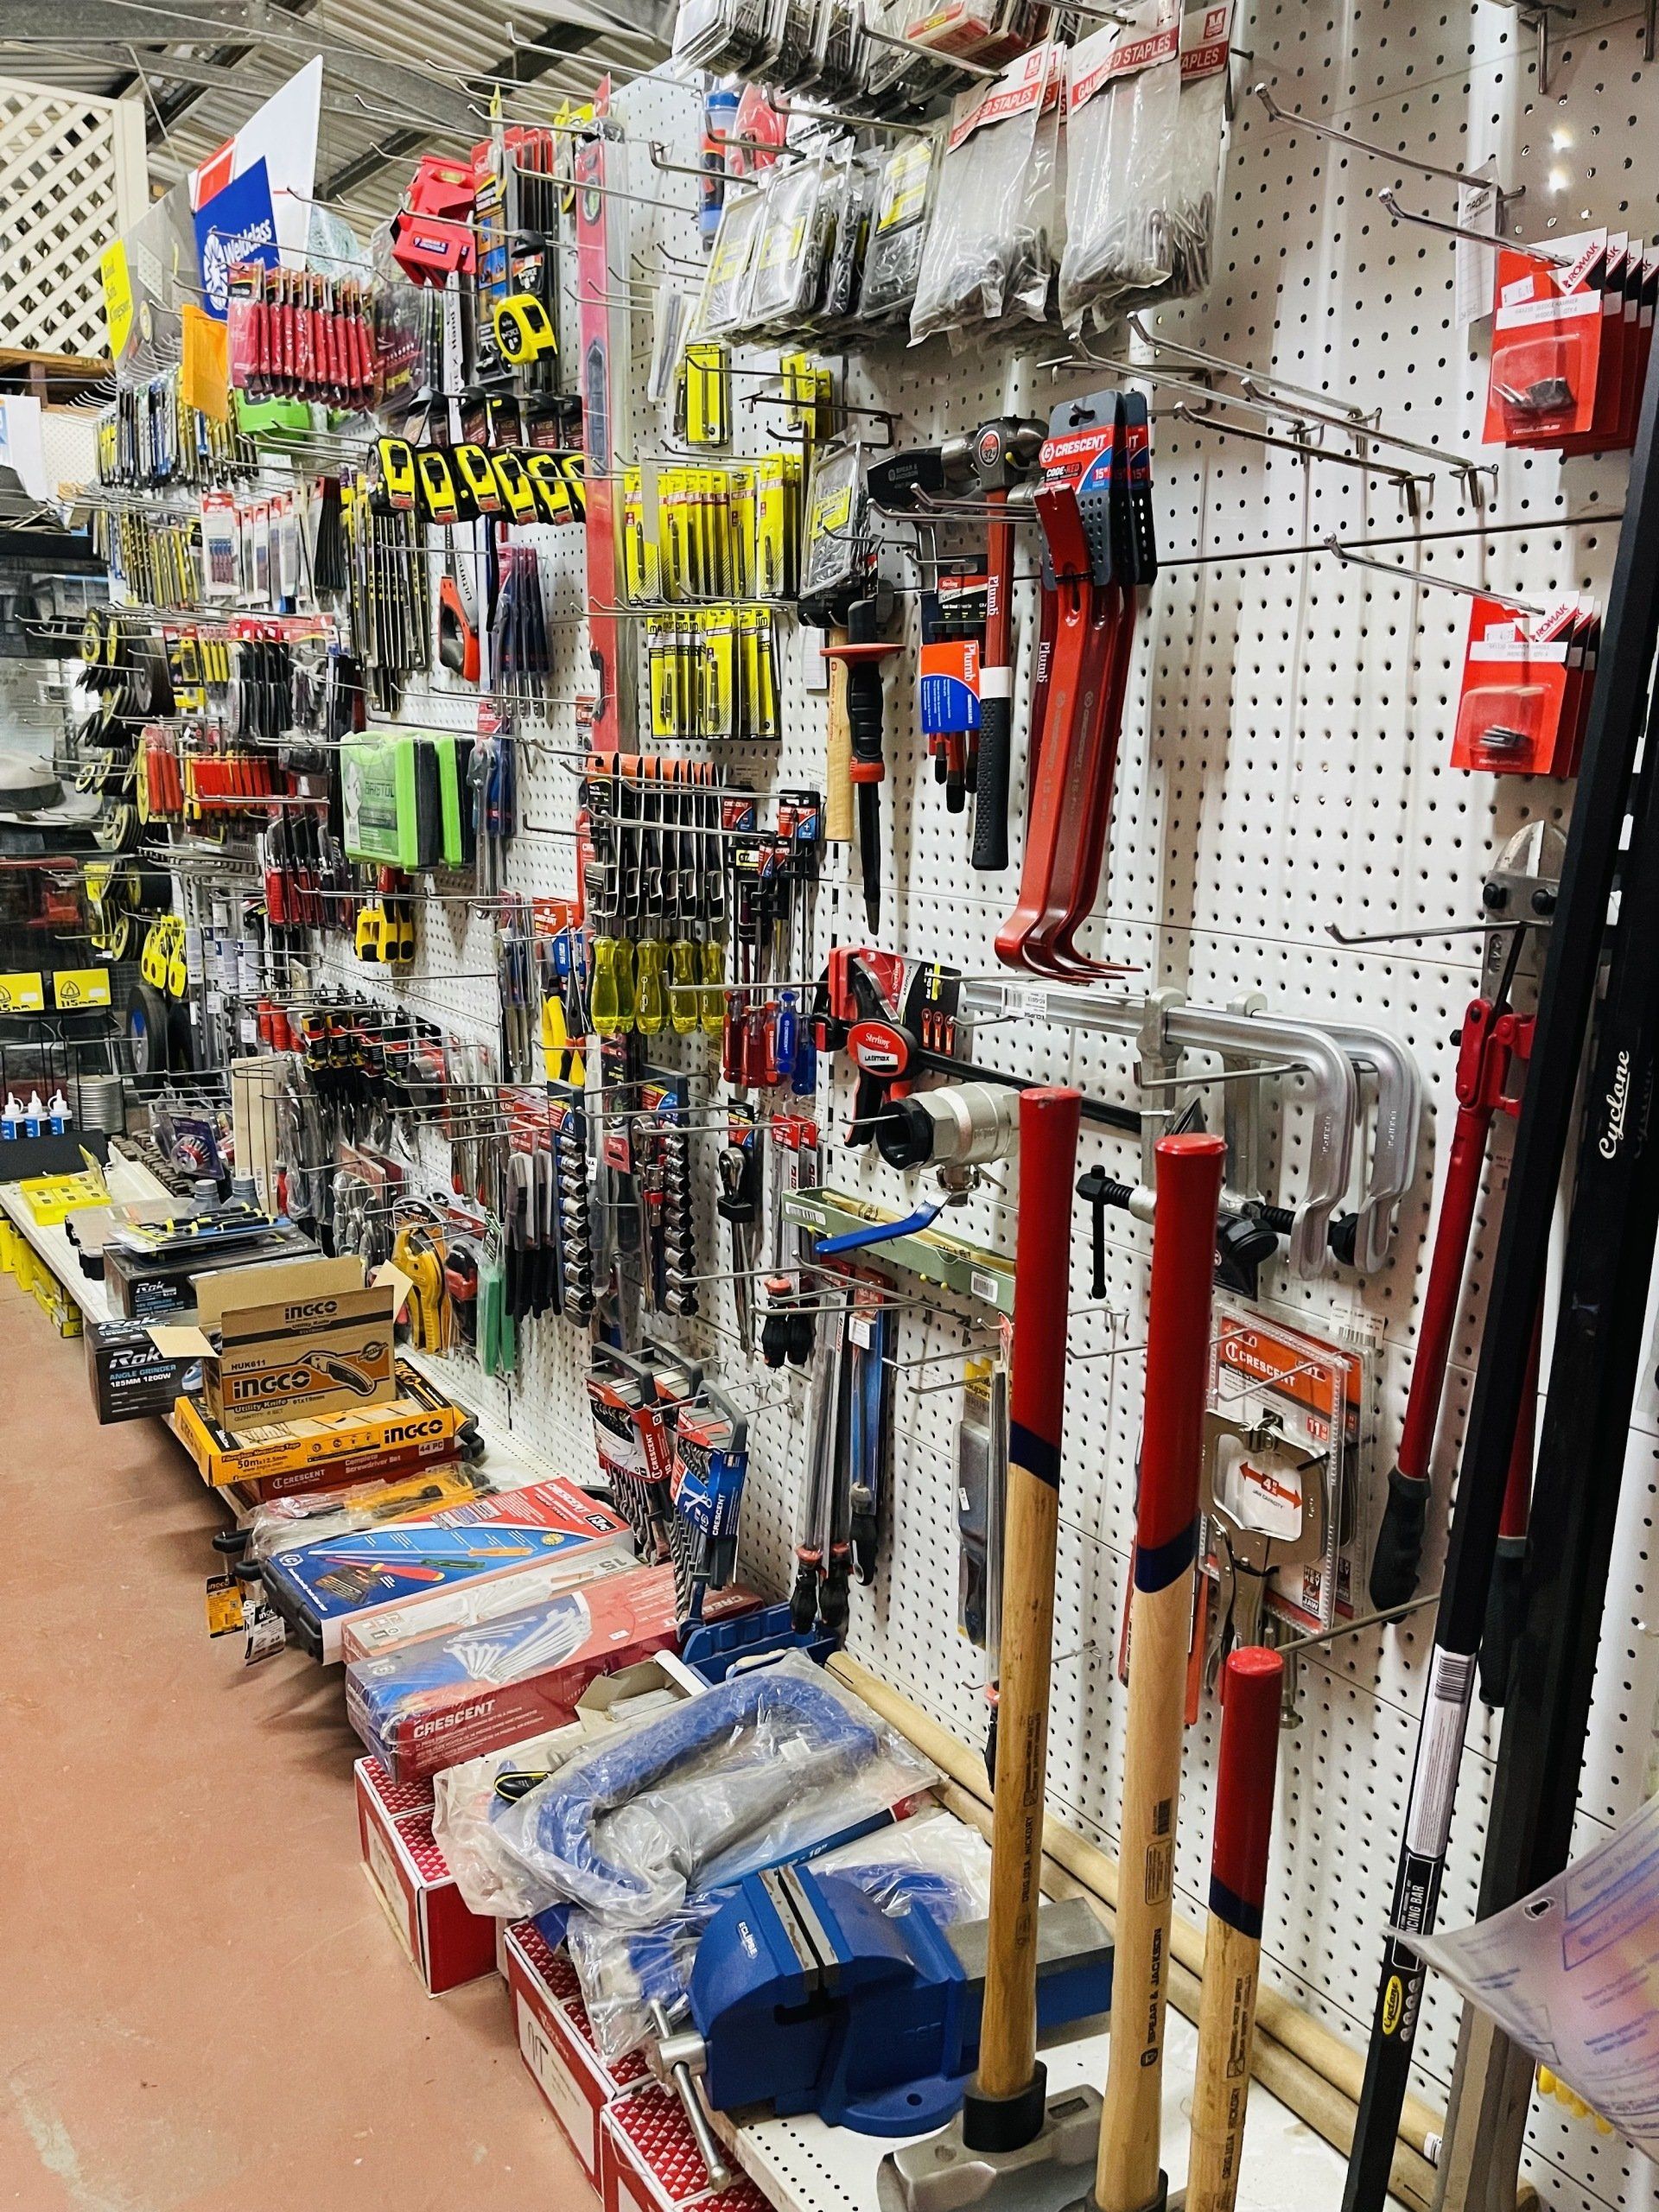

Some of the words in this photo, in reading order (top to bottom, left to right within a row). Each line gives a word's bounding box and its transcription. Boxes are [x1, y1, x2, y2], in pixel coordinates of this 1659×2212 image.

[1123, 34, 1171, 65] STAPLES
[1181, 47, 1220, 70] APLES
[991, 86, 1033, 116] STAPLES
[223, 219, 273, 265] Weldclass
[1567, 241, 1600, 283] ROMAK
[1054, 434, 1106, 458] CRESCENT
[988, 575, 1000, 616] Plumb
[1535, 602, 1568, 638] ROMAK
[963, 643, 976, 682] Plumb
[1037, 641, 1051, 683] Plumb
[60, 998, 99, 1008] 115mm
[865, 1032, 891, 1050] Sterling
[1599, 1050, 1630, 1160] Cyclone
[136, 1281, 165, 1294] Rok
[284, 1300, 338, 1320] INGCO
[109, 1346, 162, 1370] Rok
[110, 1370, 137, 1382] ANGLE
[140, 1363, 176, 1376] GRINDER
[1239, 1351, 1296, 1388] CRESCENT
[110, 1377, 142, 1389] 125MM
[143, 1372, 172, 1384] 1200W
[233, 1370, 312, 1400] INGCO
[233, 1402, 262, 1414] Utility
[262, 1398, 288, 1410] Knife
[384, 1419, 443, 1445] INGCO
[419, 1443, 431, 1453] 44
[432, 1441, 444, 1452] PC
[389, 1454, 402, 1465] Set
[645, 1433, 659, 1469] CRESCENT
[283, 1469, 326, 1486] CRESCENT
[545, 1483, 591, 1513] CRESCENT
[712, 1493, 726, 1536] CRESCENT
[1302, 1598, 1319, 1611] JAW
[413, 1698, 497, 1739] CRESCENT
[1024, 1816, 1033, 1856] HICKORY
[1410, 1885, 1425, 1905] BAR
[1405, 1904, 1421, 1935] NCING
[737, 1921, 758, 1955] ECLIPSE
[1150, 1928, 1162, 1987] JACKSON
[1149, 1989, 1159, 2000] &
[1383, 1980, 1400, 2029] Cyclone
[1147, 2002, 1158, 2045] SPEAR
